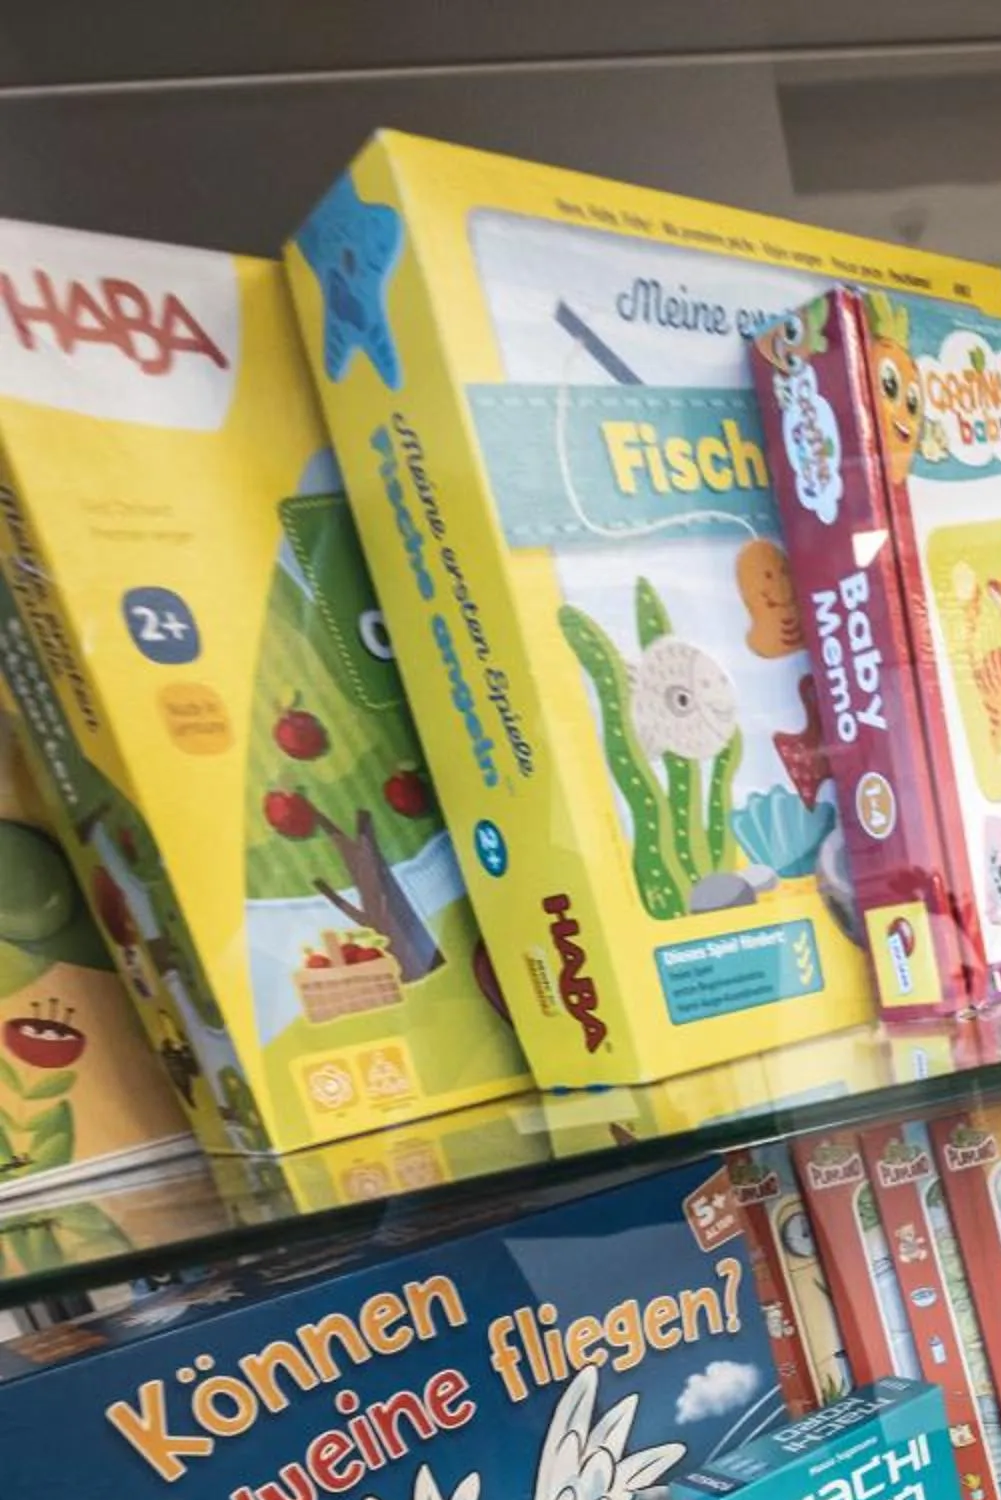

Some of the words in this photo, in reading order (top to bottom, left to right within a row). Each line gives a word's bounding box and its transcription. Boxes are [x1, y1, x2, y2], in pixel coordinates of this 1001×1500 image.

[0, 268, 231, 377] HABA
[616, 277, 730, 336] Meine
[130, 603, 191, 641] 2+
[813, 590, 857, 743] Memo
[839, 571, 888, 731] Baby
[542, 892, 608, 1055] HABA
[691, 1192, 728, 1227] 5+
[106, 1274, 467, 1483] Können
[489, 1258, 745, 1405] fliegen?
